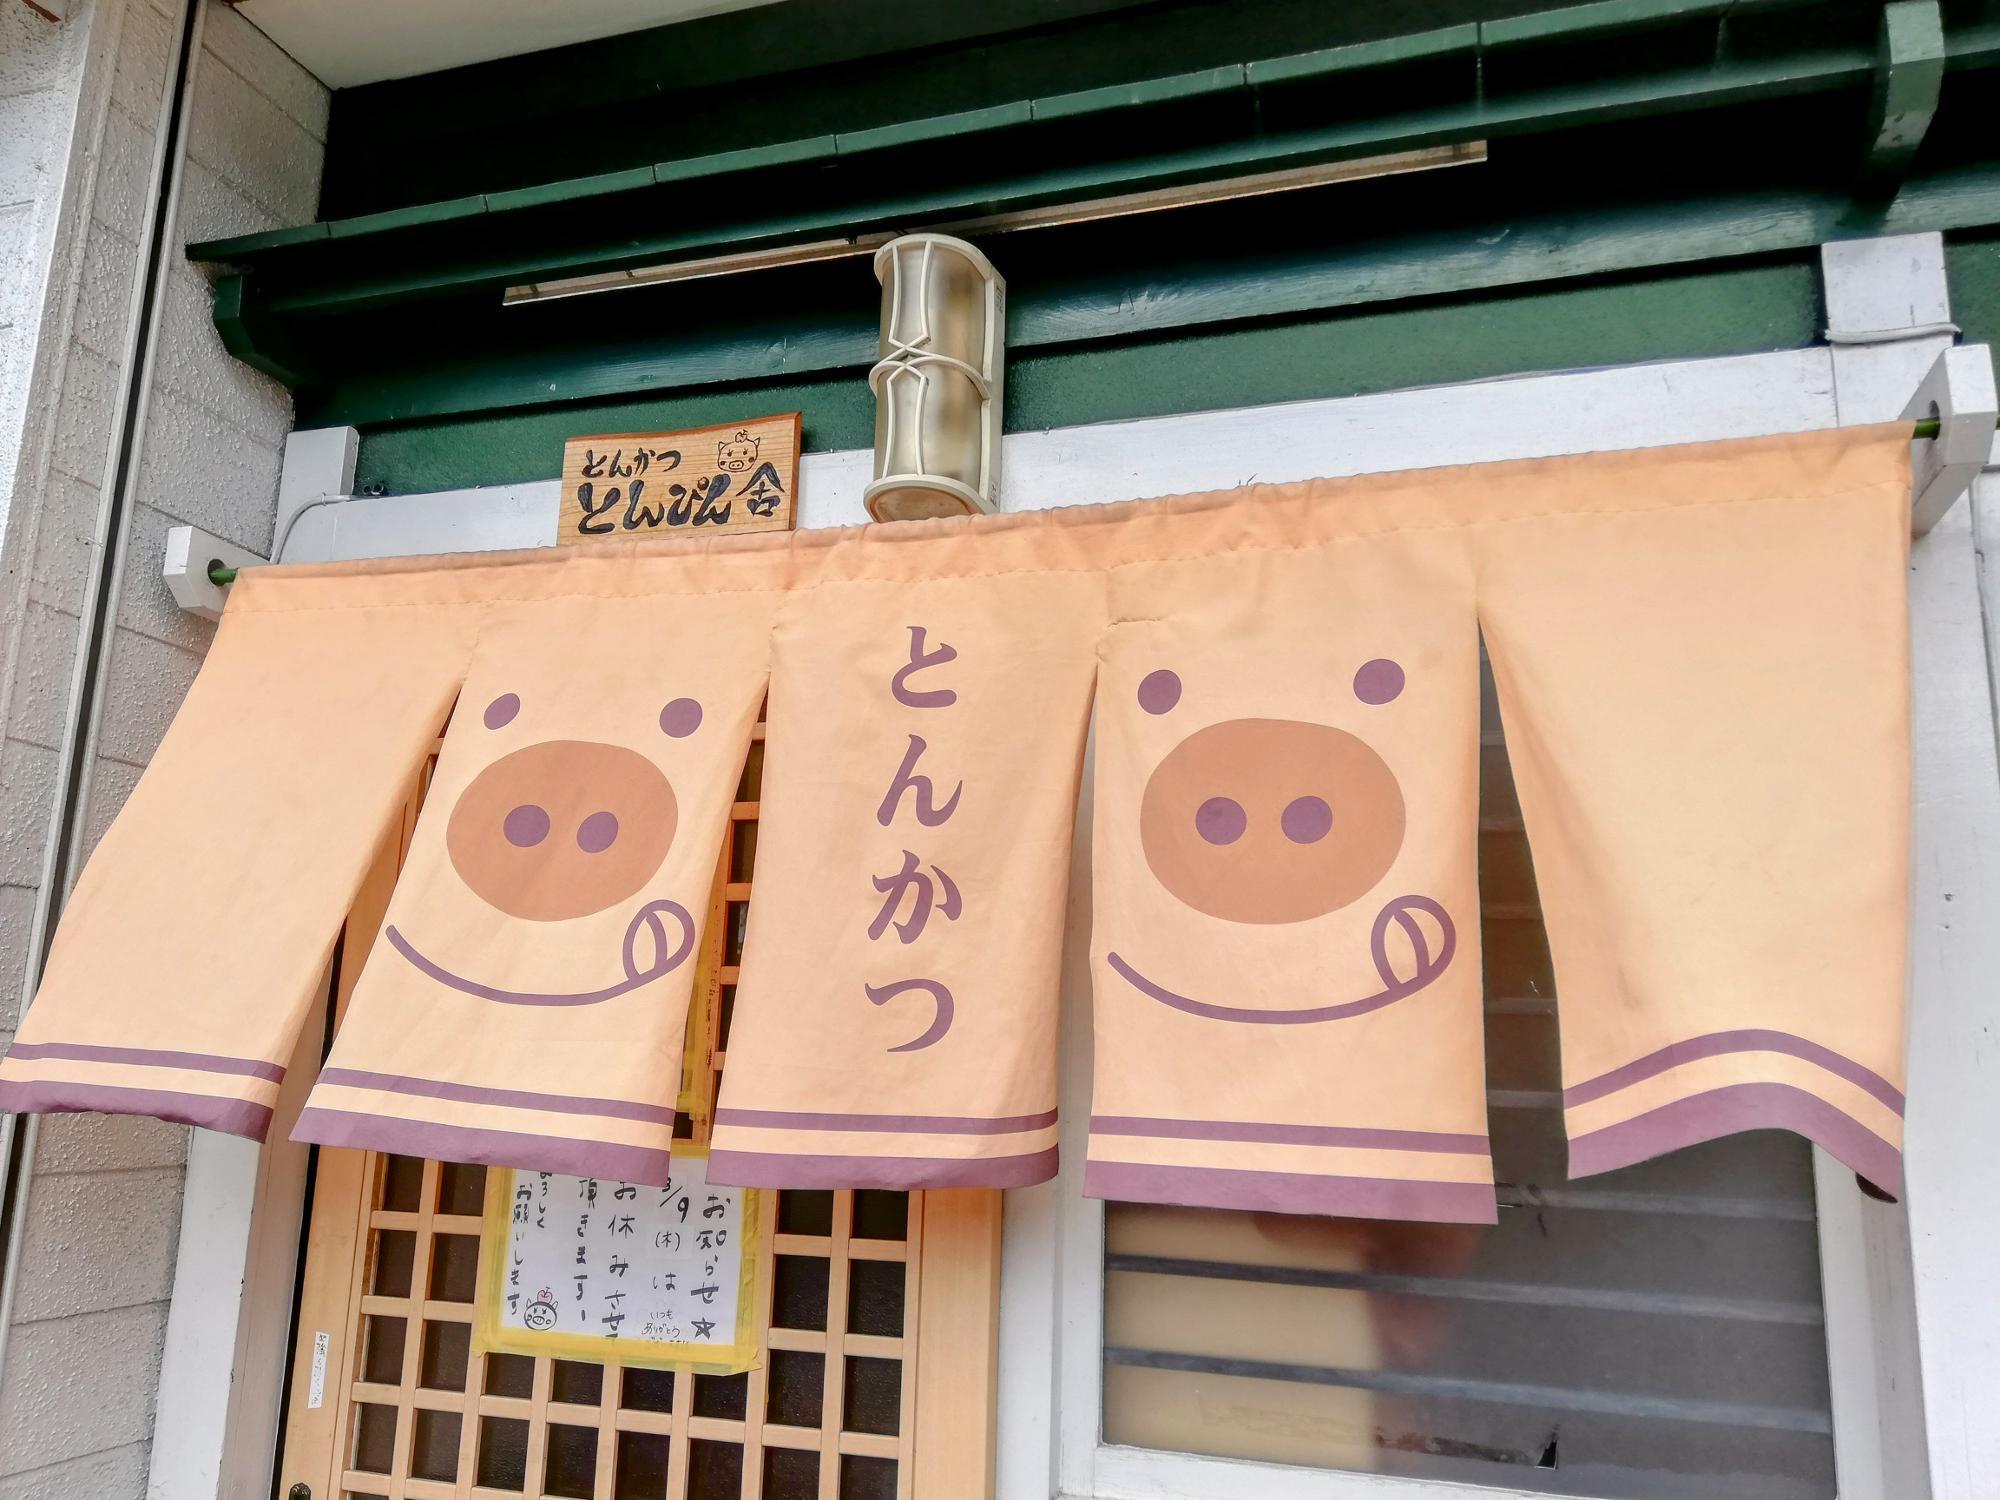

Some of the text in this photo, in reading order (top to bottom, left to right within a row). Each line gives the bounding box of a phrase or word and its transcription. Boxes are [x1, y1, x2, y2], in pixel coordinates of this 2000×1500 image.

[581, 447, 681, 478] とんかつ
[864, 626, 963, 1053] とんかつ
[602, 1181, 637, 1339] お休みさせ
